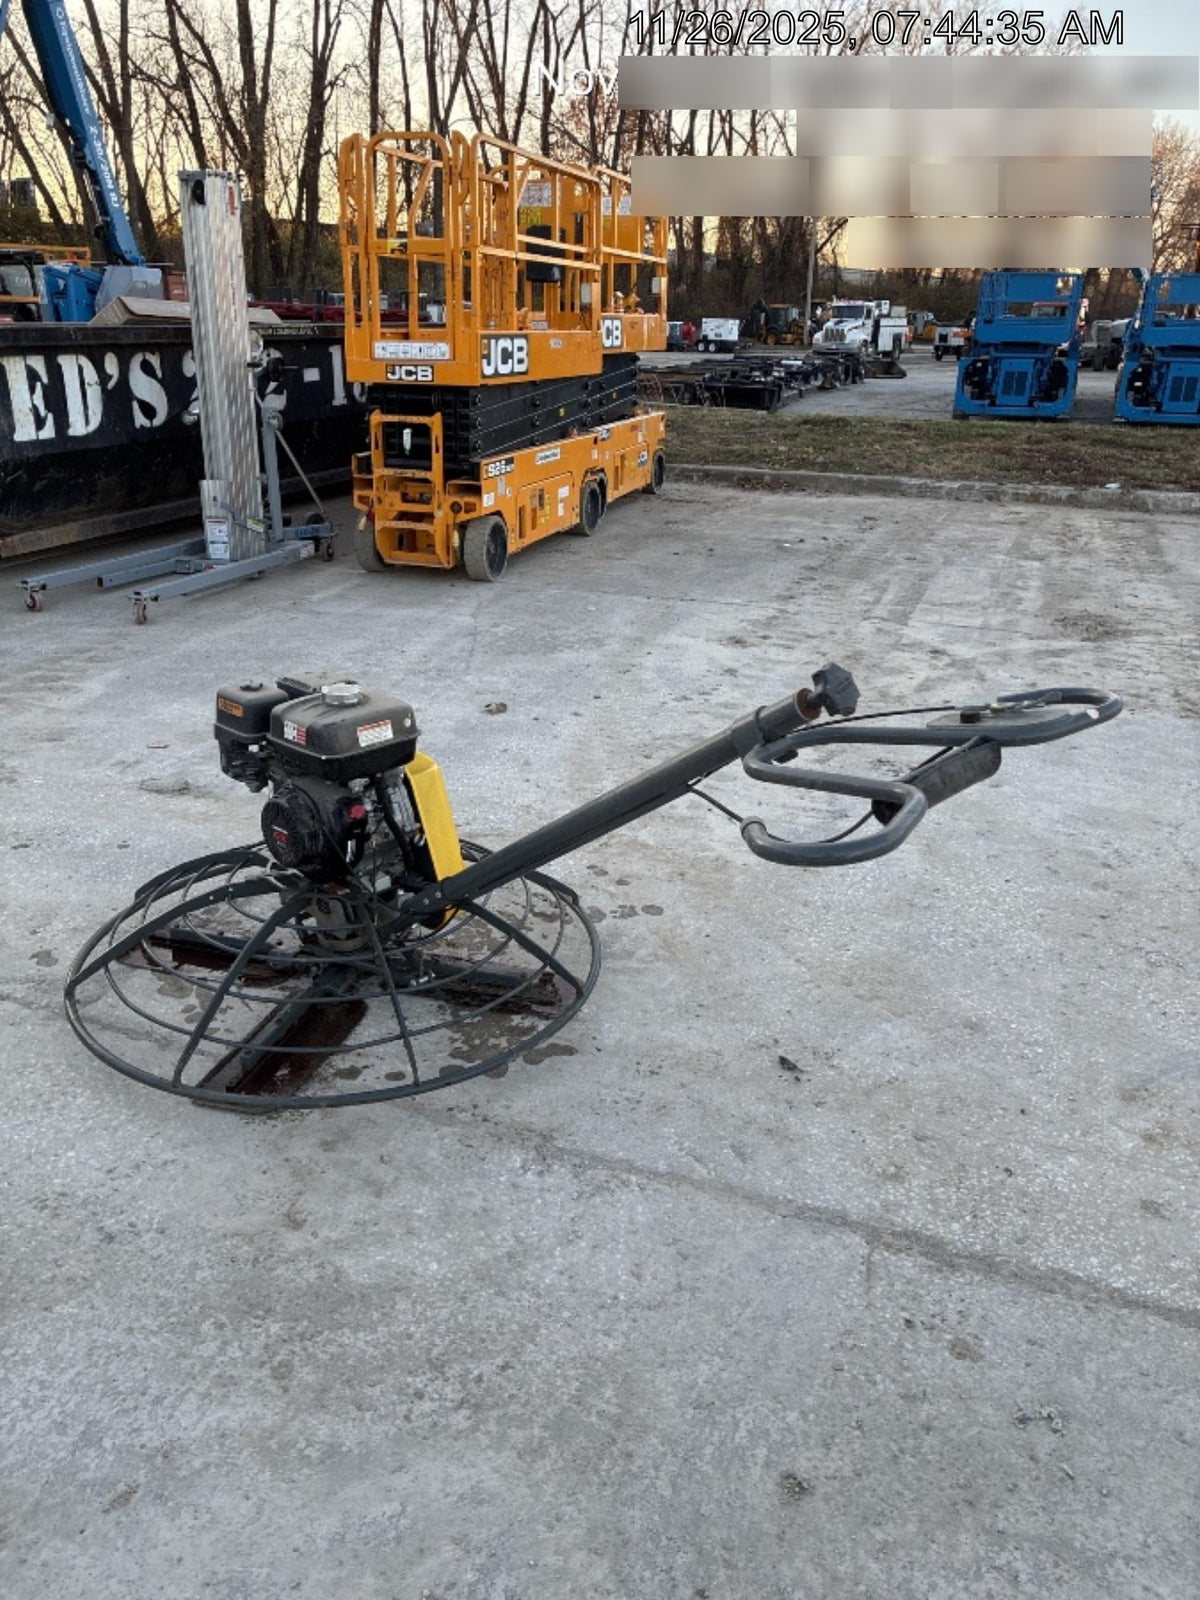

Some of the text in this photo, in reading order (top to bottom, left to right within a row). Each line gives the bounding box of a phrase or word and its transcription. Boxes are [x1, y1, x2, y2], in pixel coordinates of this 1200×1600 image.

[602, 318, 621, 348] CB
[482, 337, 528, 376] JCB
[386, 365, 434, 381] JCB
